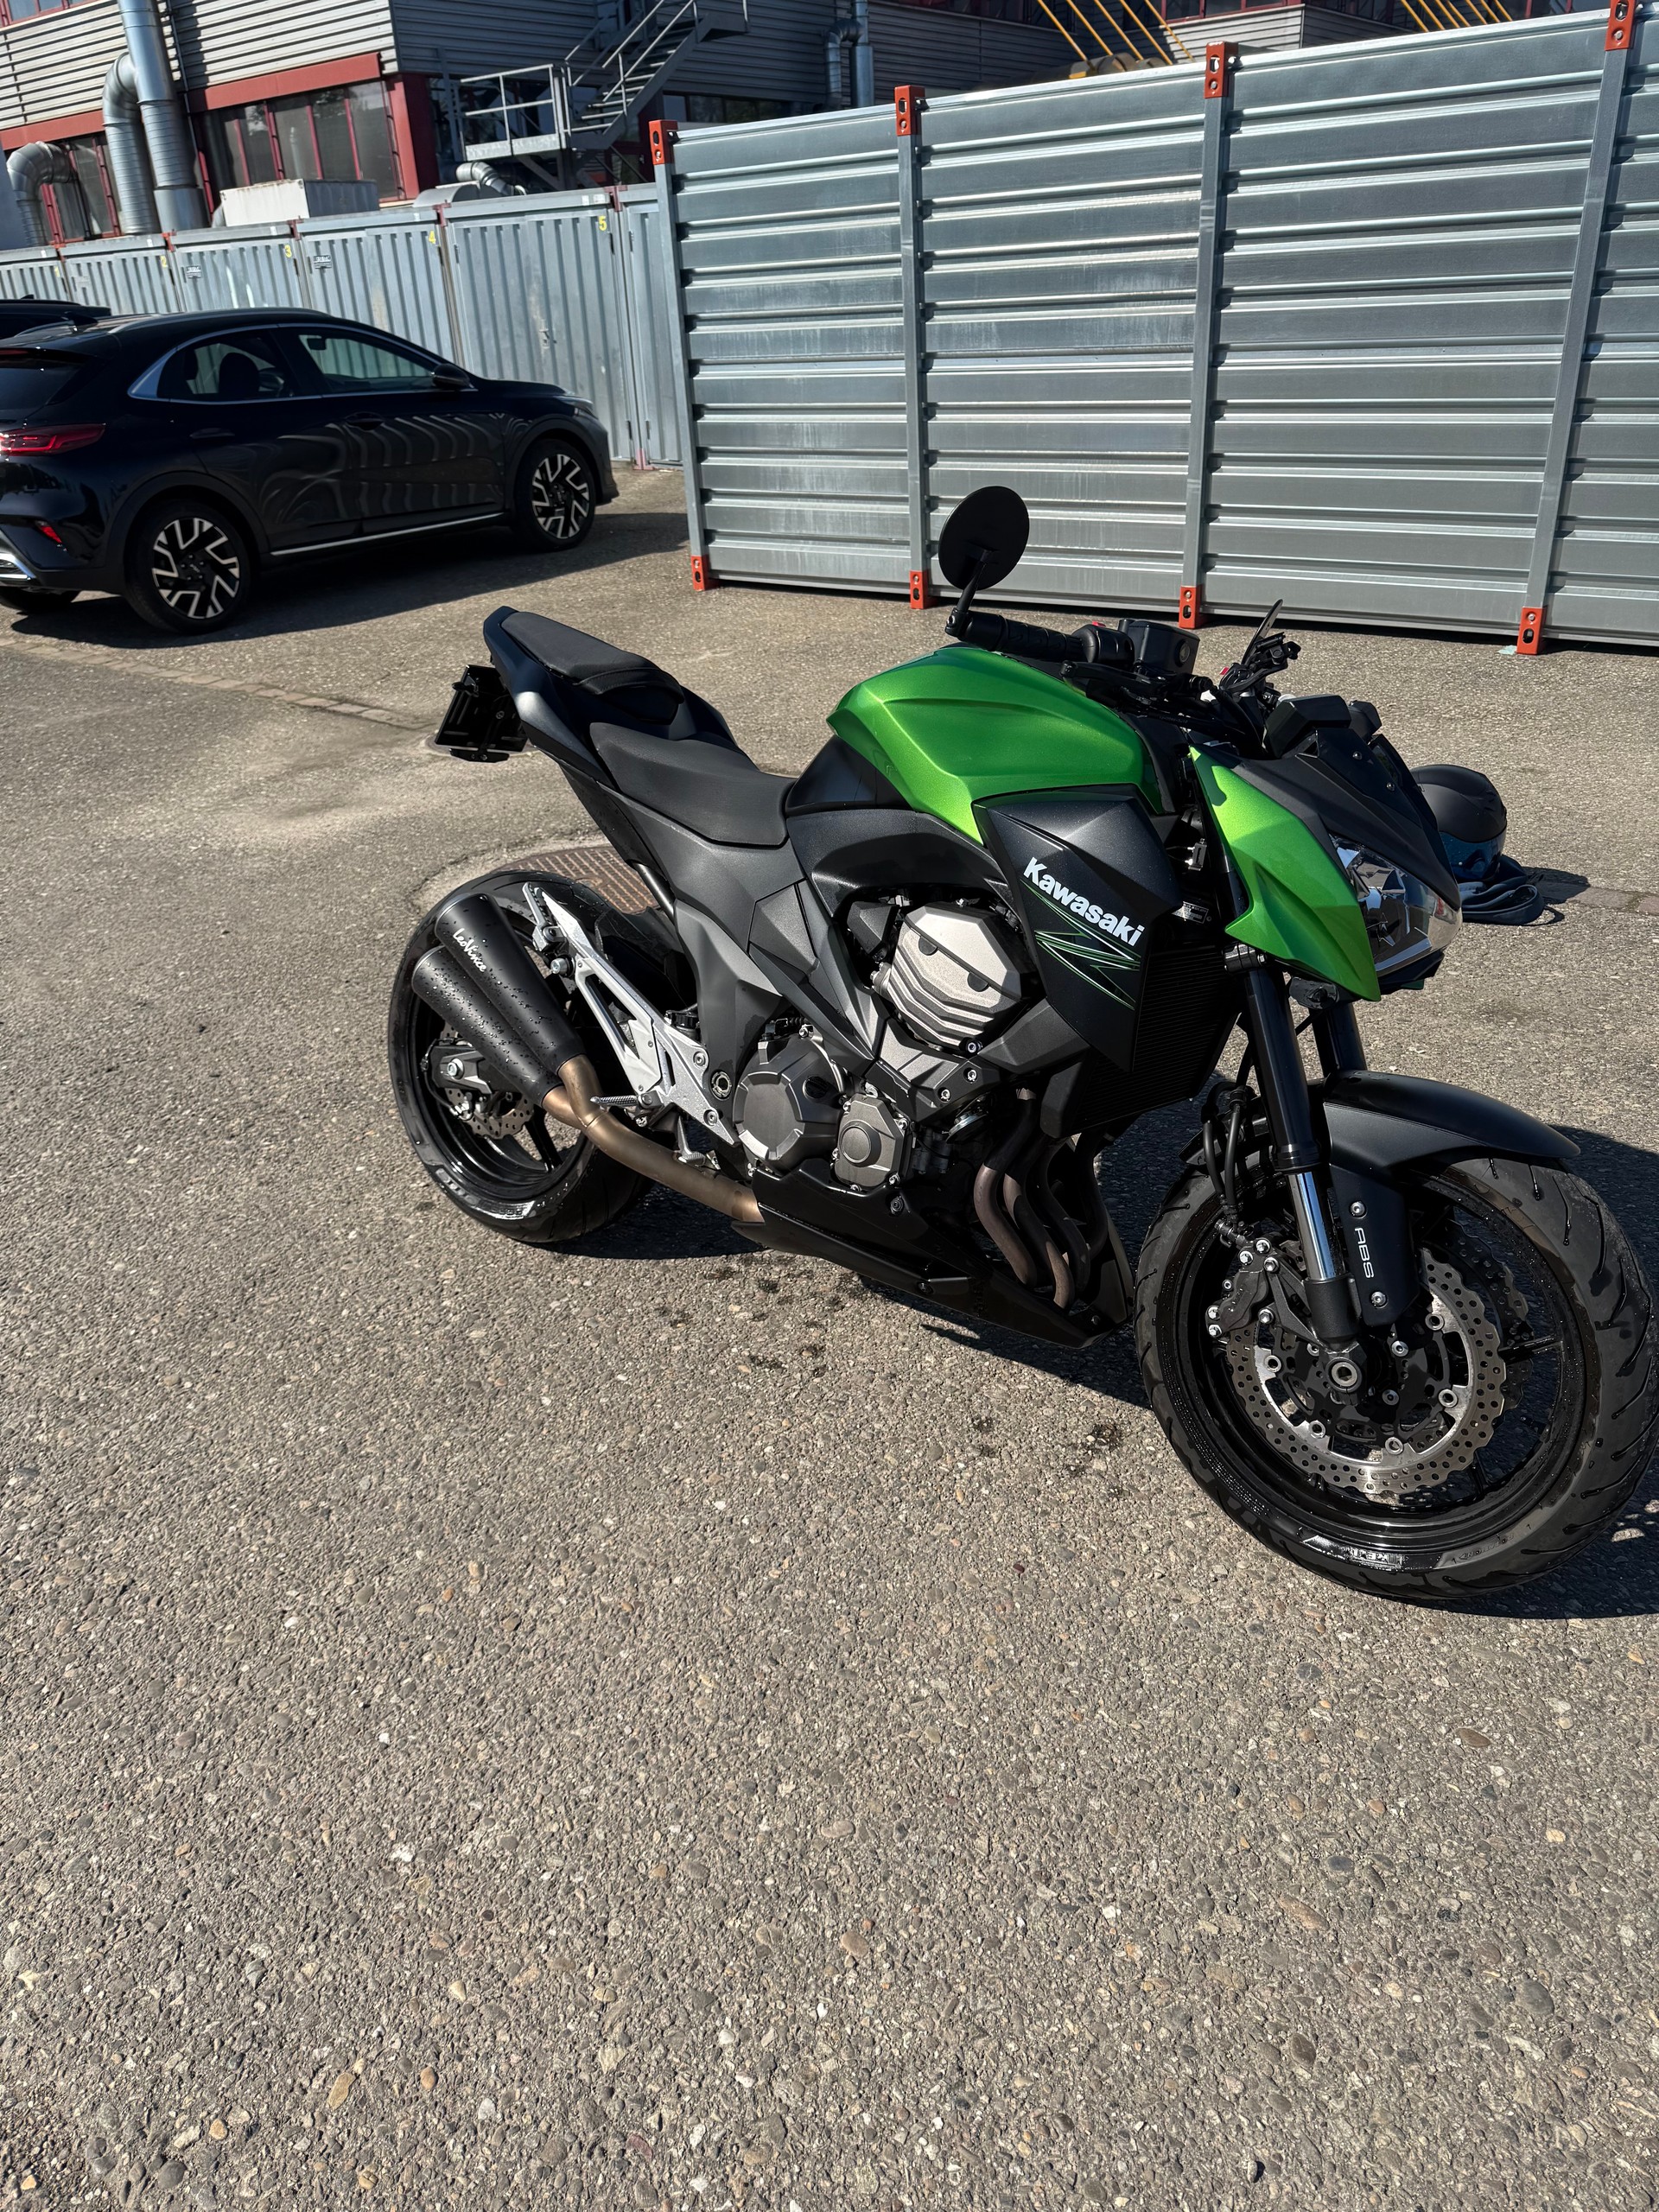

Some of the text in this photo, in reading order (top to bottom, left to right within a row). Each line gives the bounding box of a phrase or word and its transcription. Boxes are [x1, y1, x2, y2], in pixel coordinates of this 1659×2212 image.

[598, 215, 607, 231] 5
[429, 230, 436, 245] 4
[283, 245, 292, 258] 3
[1023, 856, 1145, 947] Kawasaki
[1354, 1227, 1375, 1279] ABS
